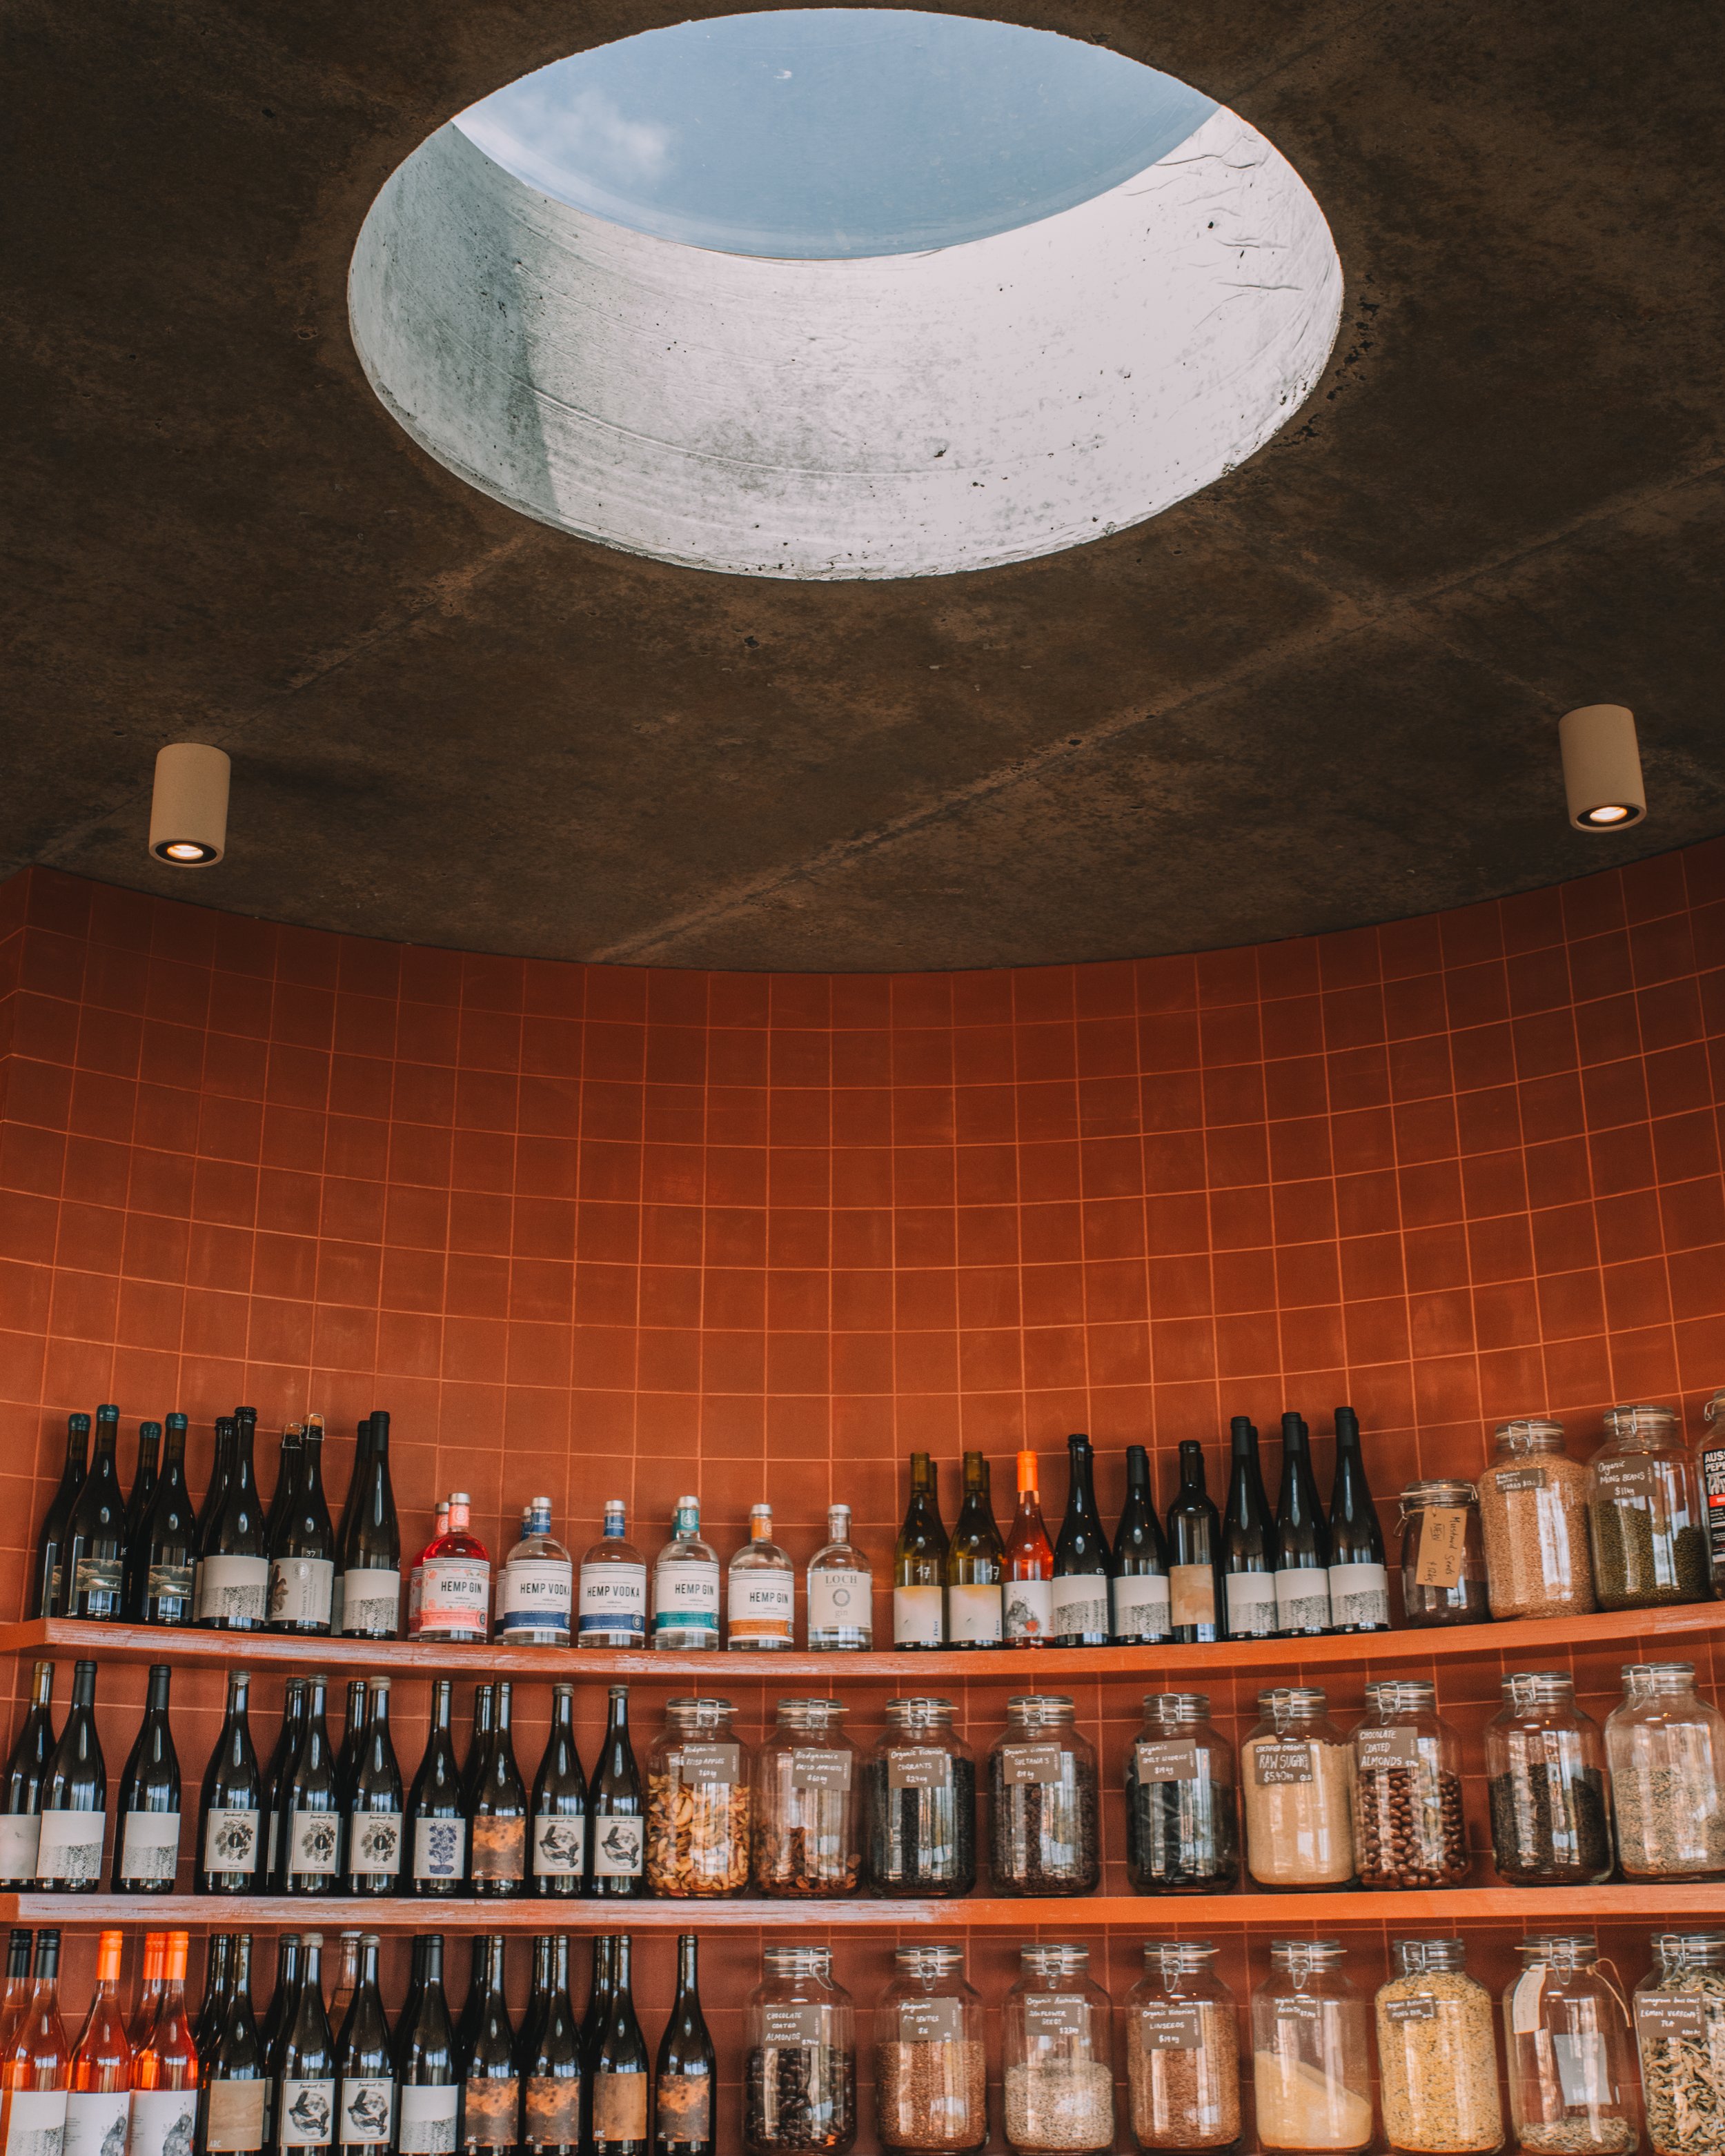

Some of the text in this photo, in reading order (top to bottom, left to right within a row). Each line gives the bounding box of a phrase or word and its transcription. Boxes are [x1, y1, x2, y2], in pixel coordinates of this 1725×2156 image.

[1598, 1460, 1626, 1476] Organic
[1600, 1475, 1620, 1485] MUNG
[1622, 1472, 1645, 1482] BEANS
[1433, 1523, 1443, 1542] NEW
[1445, 1516, 1461, 1575] Mustard Seeds
[825, 1575, 857, 1584] LOCH
[441, 1581, 482, 1593] HEMP GIN
[521, 1583, 570, 1596] HEMP VODKA
[587, 1585, 640, 1598] HEMP VODKA
[675, 1583, 713, 1595] HEMP GIN
[750, 1592, 789, 1603] HEMP GIN
[1360, 1730, 1397, 1740] CHOCOLATE
[1140, 1744, 1167, 1755] Organic
[1365, 1742, 1390, 1753] COATED
[796, 1751, 838, 1762] Biodynamic
[891, 1750, 916, 1761] Organic
[1004, 1749, 1027, 1758] Organic
[1259, 1754, 1304, 1769] RAW SUGAR
[1361, 1756, 1402, 1767] ALMONDS
[1027, 1998, 1052, 2008] Organic
[766, 2012, 802, 2020] CHOCOLATE
[1143, 2010, 1166, 2019] Organic
[765, 2032, 801, 2041] ALMONDS
